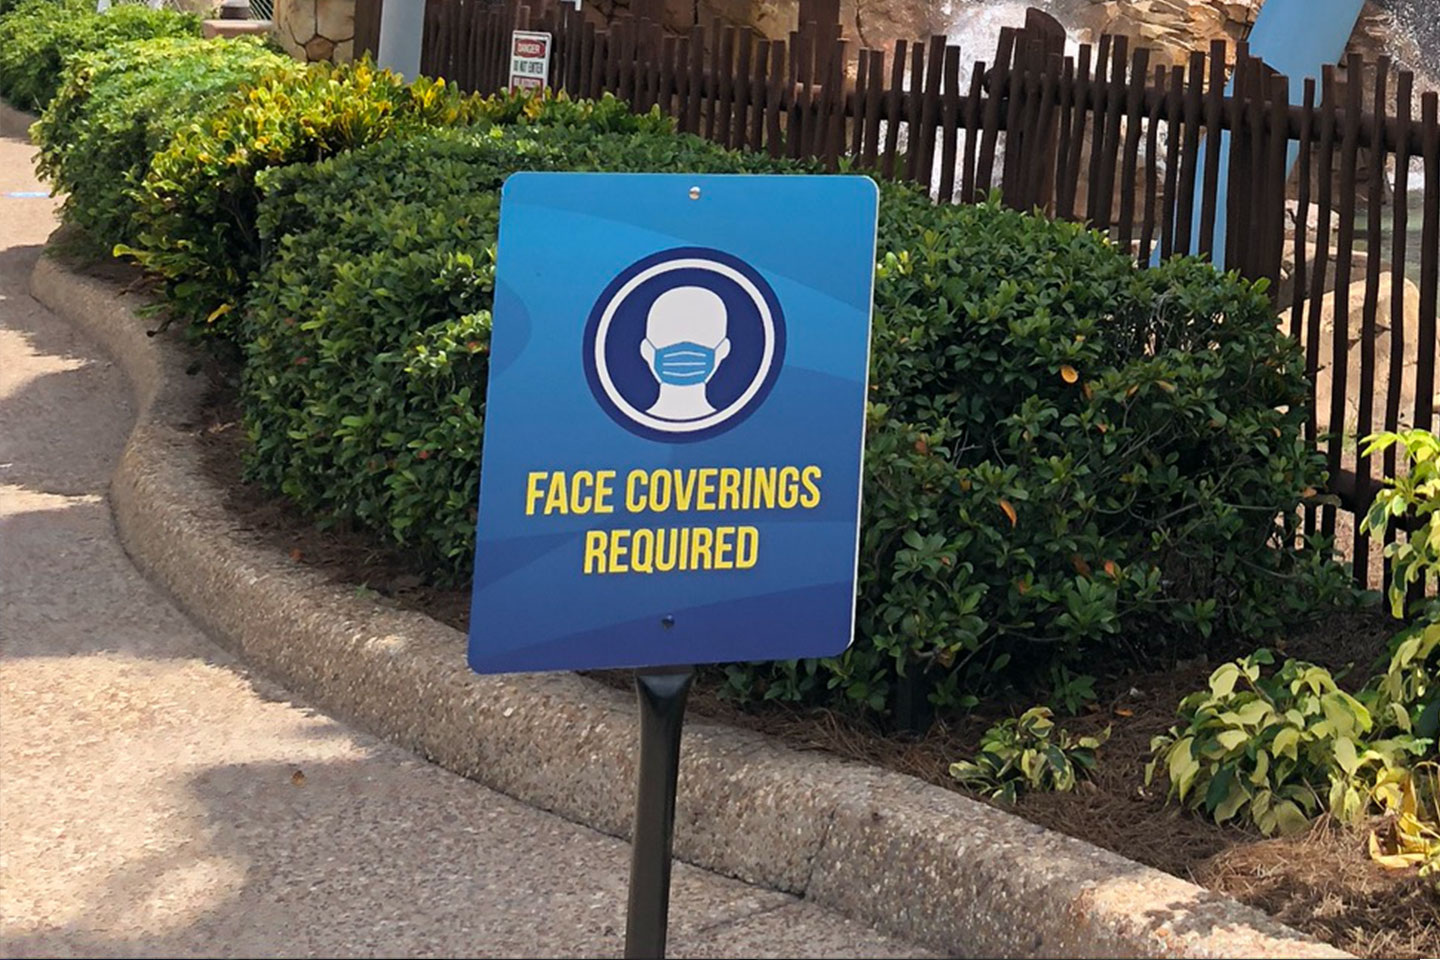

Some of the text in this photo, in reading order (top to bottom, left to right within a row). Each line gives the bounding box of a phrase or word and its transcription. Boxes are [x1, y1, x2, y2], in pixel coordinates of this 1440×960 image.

[525, 465, 823, 516] FACE COVERINGS
[583, 526, 760, 575] REQUIRED
